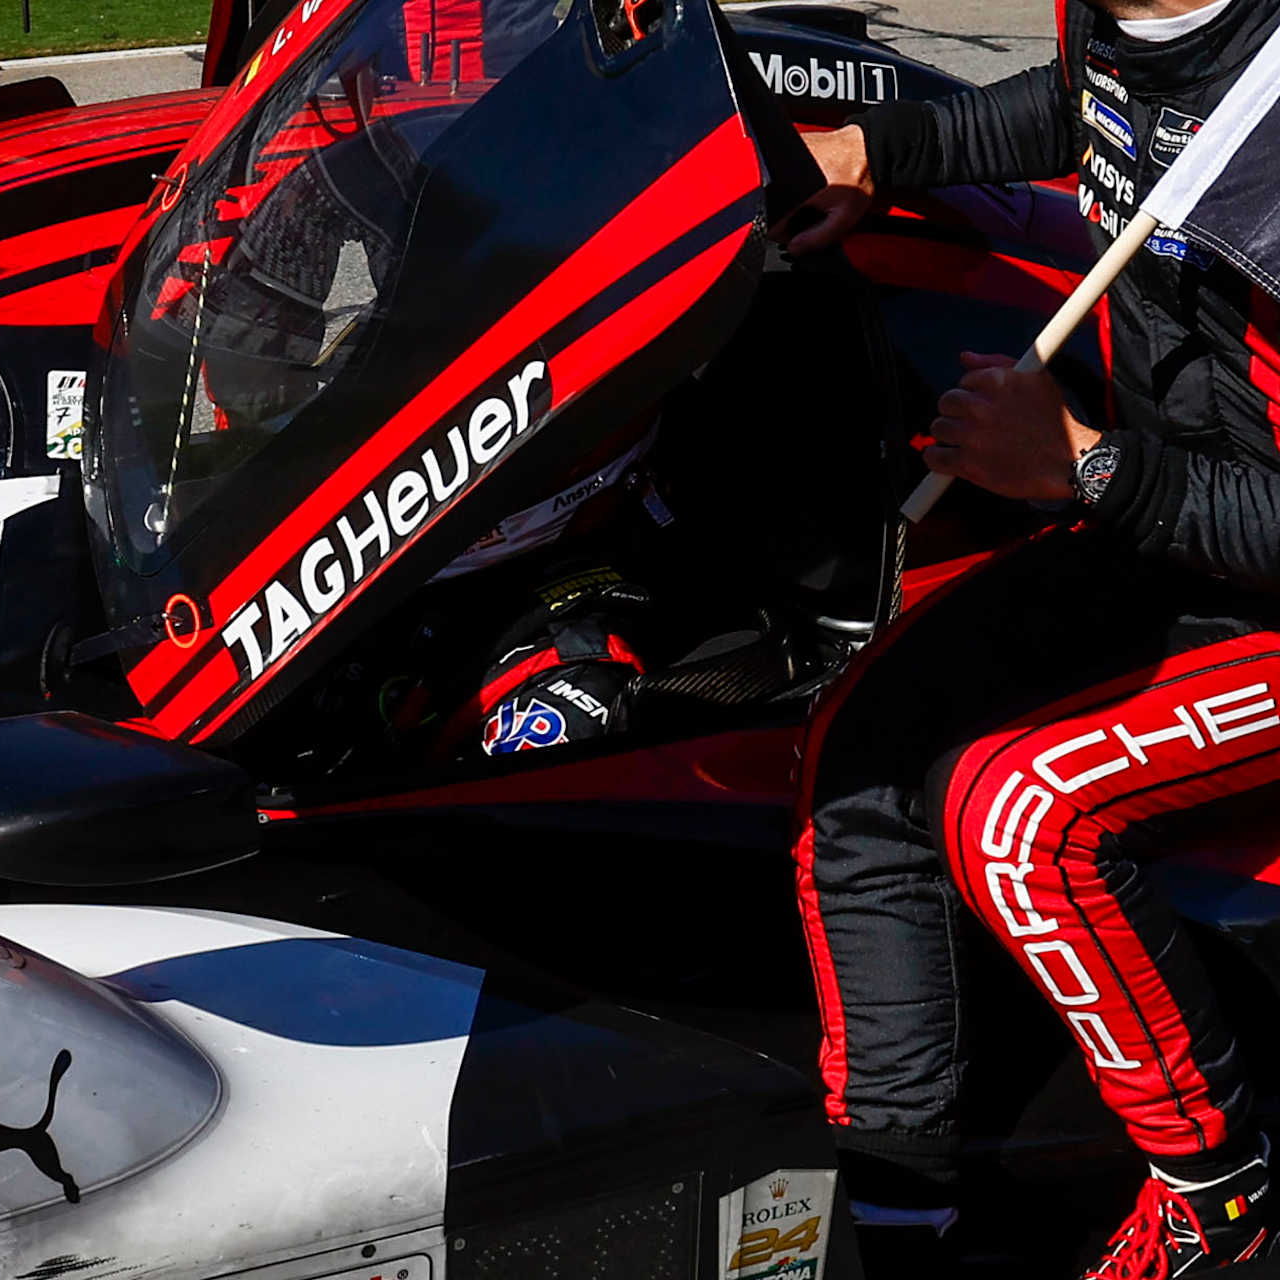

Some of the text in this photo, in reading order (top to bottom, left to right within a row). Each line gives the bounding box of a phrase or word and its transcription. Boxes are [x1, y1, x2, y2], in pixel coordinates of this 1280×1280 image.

[271, 27, 293, 56] L.
[747, 51, 885, 102] Mobil 1
[1081, 144, 1135, 206] Ansys
[55, 406, 72, 425] 7
[546, 678, 610, 727] IMSA
[981, 681, 1280, 1071] PORSCHE
[742, 1197, 812, 1228] ROLEX
[729, 1216, 822, 1272] 24
